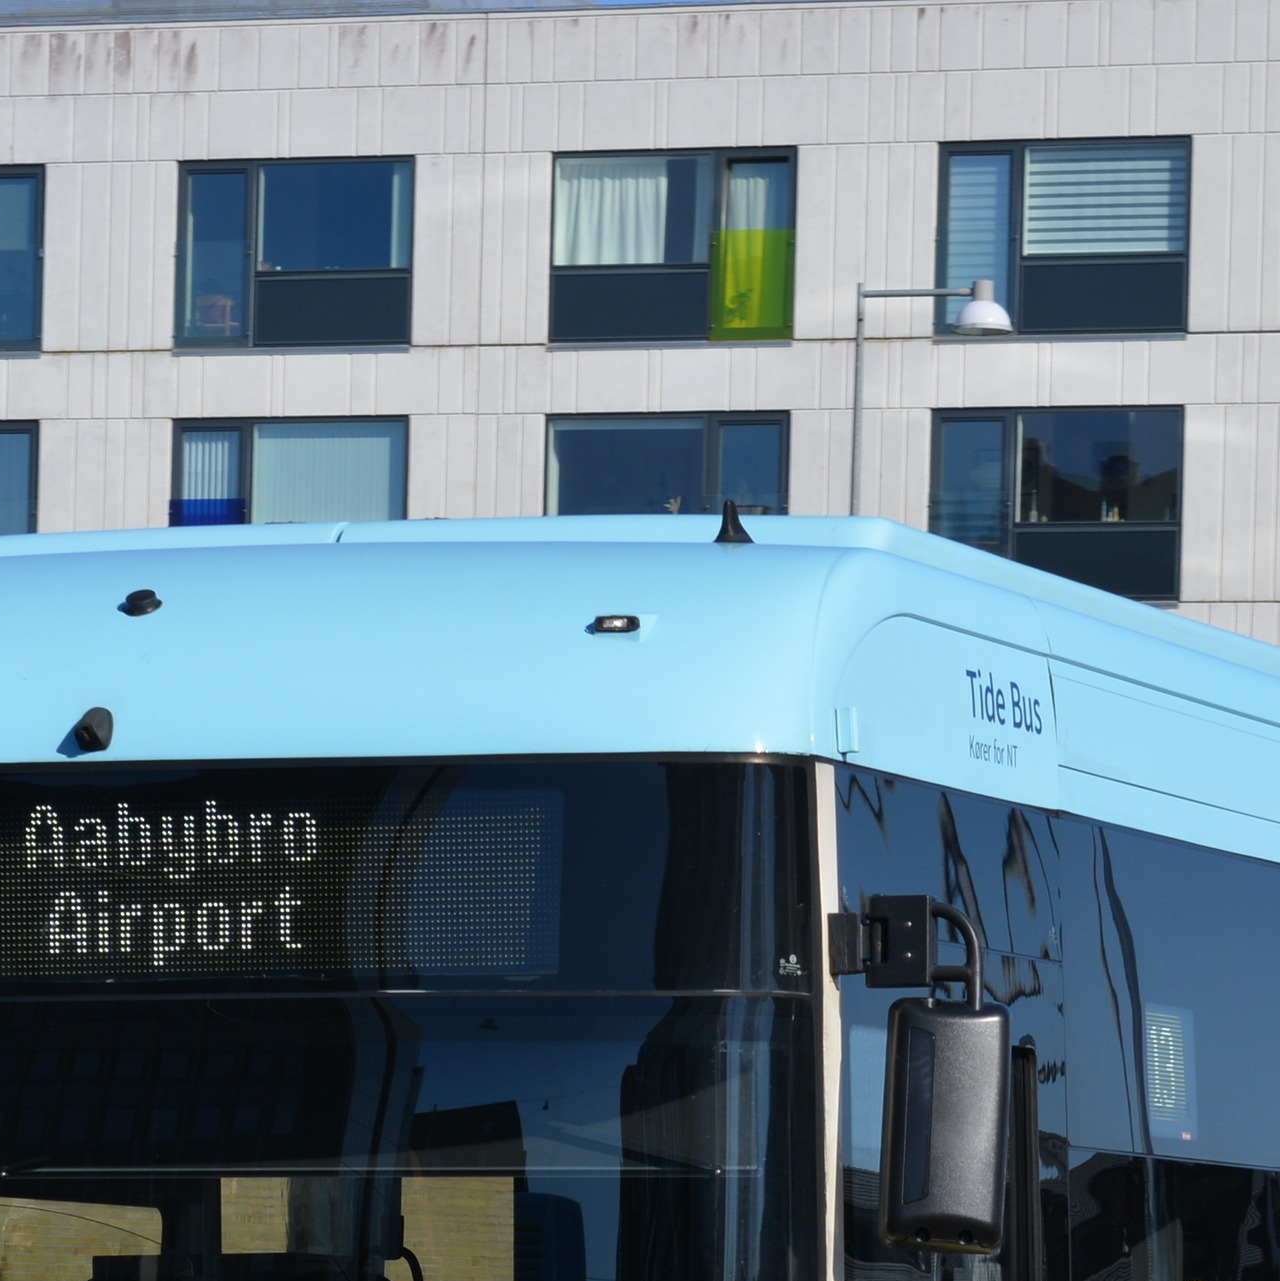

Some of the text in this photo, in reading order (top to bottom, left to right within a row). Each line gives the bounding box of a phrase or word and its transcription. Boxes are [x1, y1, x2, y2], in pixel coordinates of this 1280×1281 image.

[965, 669, 1043, 735] Tide Bus
[968, 734, 1018, 768] Kører for NT
[25, 800, 317, 879] Aabybro
[49, 887, 302, 965] Airport
